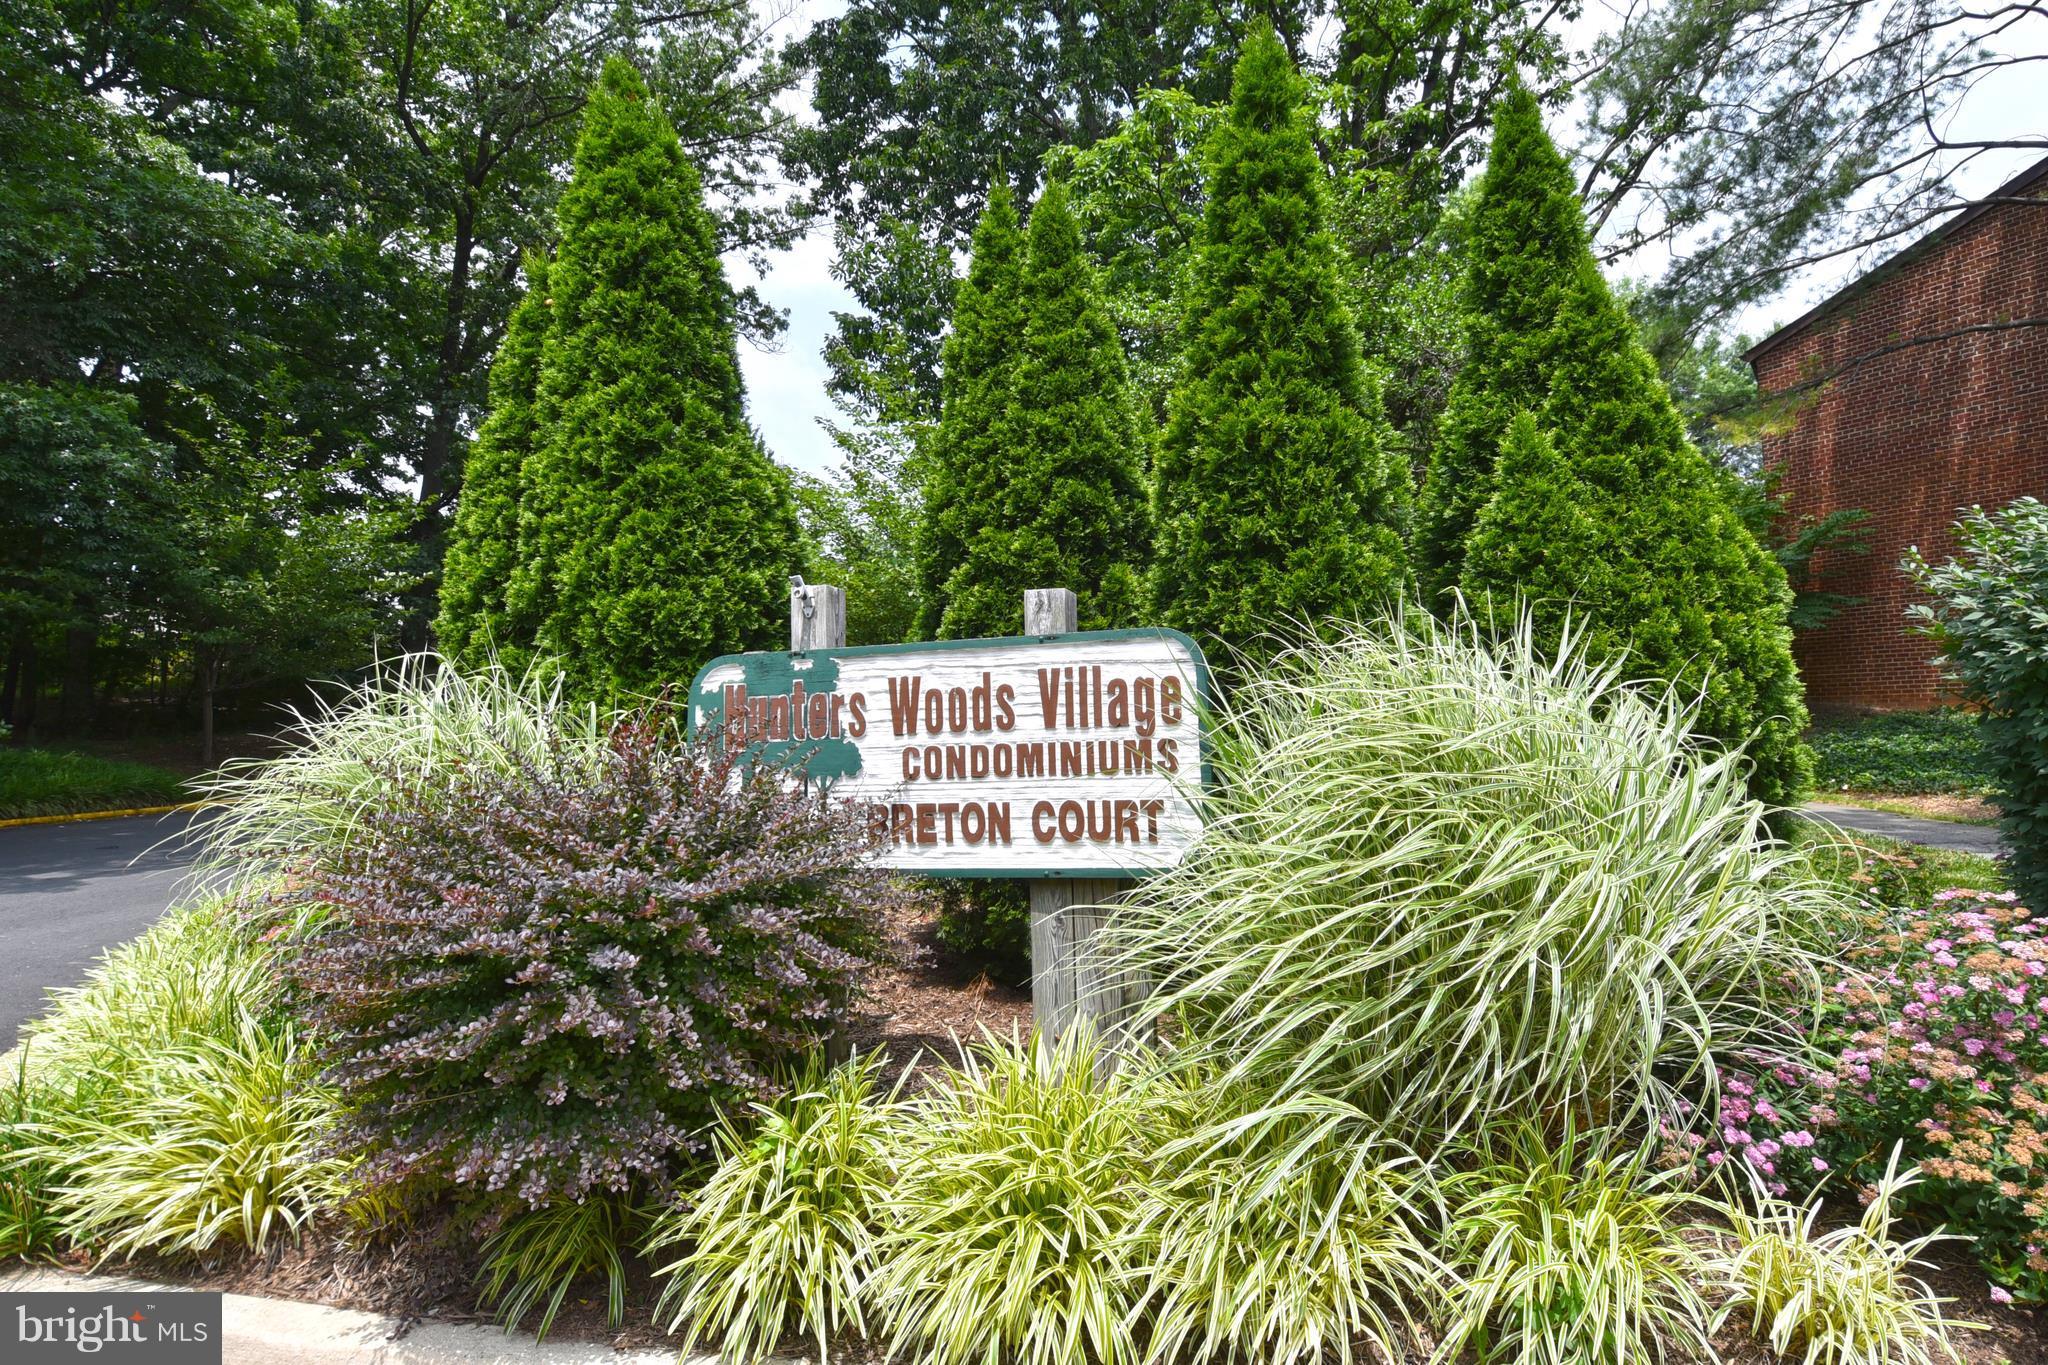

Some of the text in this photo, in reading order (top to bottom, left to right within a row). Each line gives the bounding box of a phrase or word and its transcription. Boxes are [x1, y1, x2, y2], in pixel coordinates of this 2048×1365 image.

[723, 665, 1183, 751] Hunters Woods Village
[902, 738, 1180, 781] CONDOMINIUMS
[868, 799, 1165, 845] BRETON COURT
